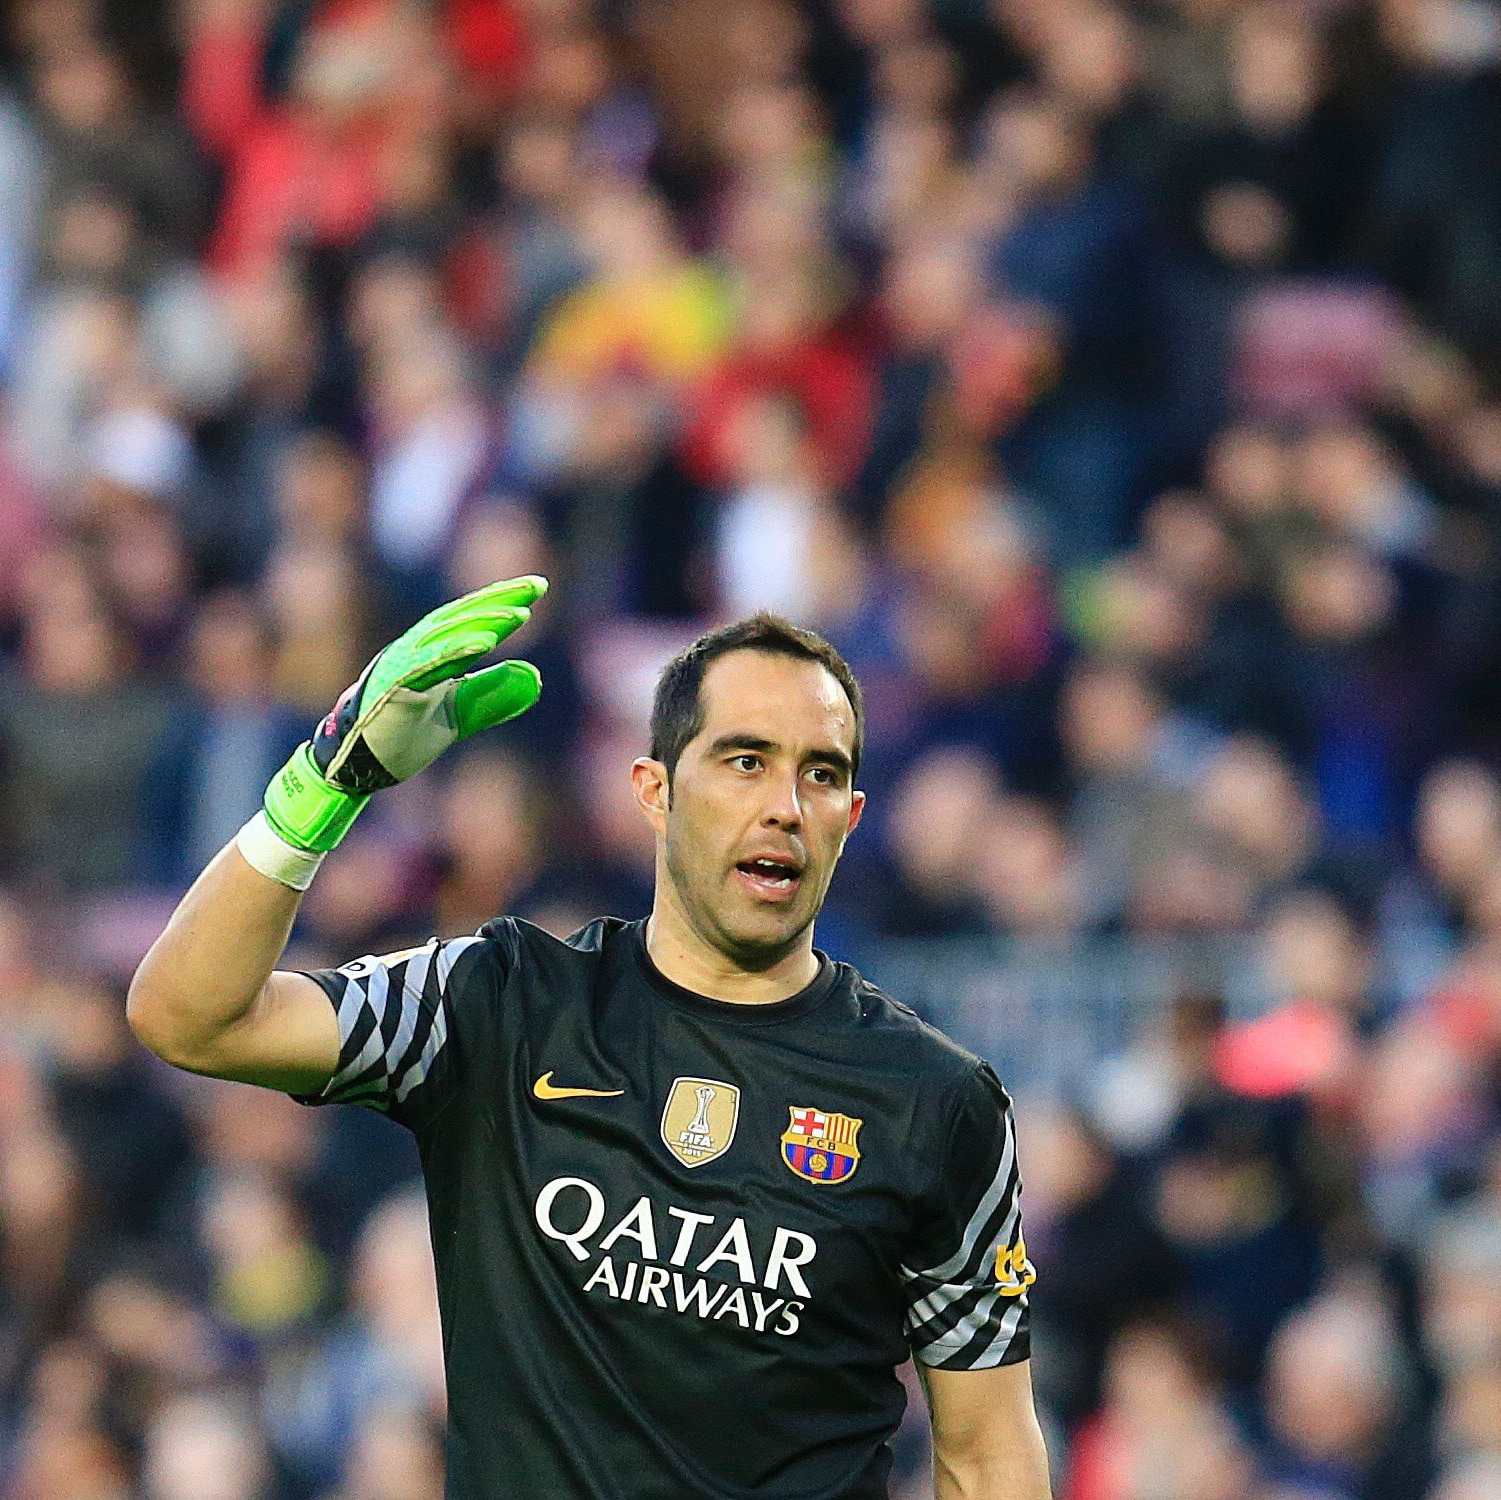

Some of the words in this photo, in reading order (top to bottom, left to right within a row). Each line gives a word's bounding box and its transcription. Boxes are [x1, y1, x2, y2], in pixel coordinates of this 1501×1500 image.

[679, 1131, 711, 1148] FIFA
[536, 1178, 816, 1298] QATAR
[583, 1257, 804, 1335] AIRWAYS
